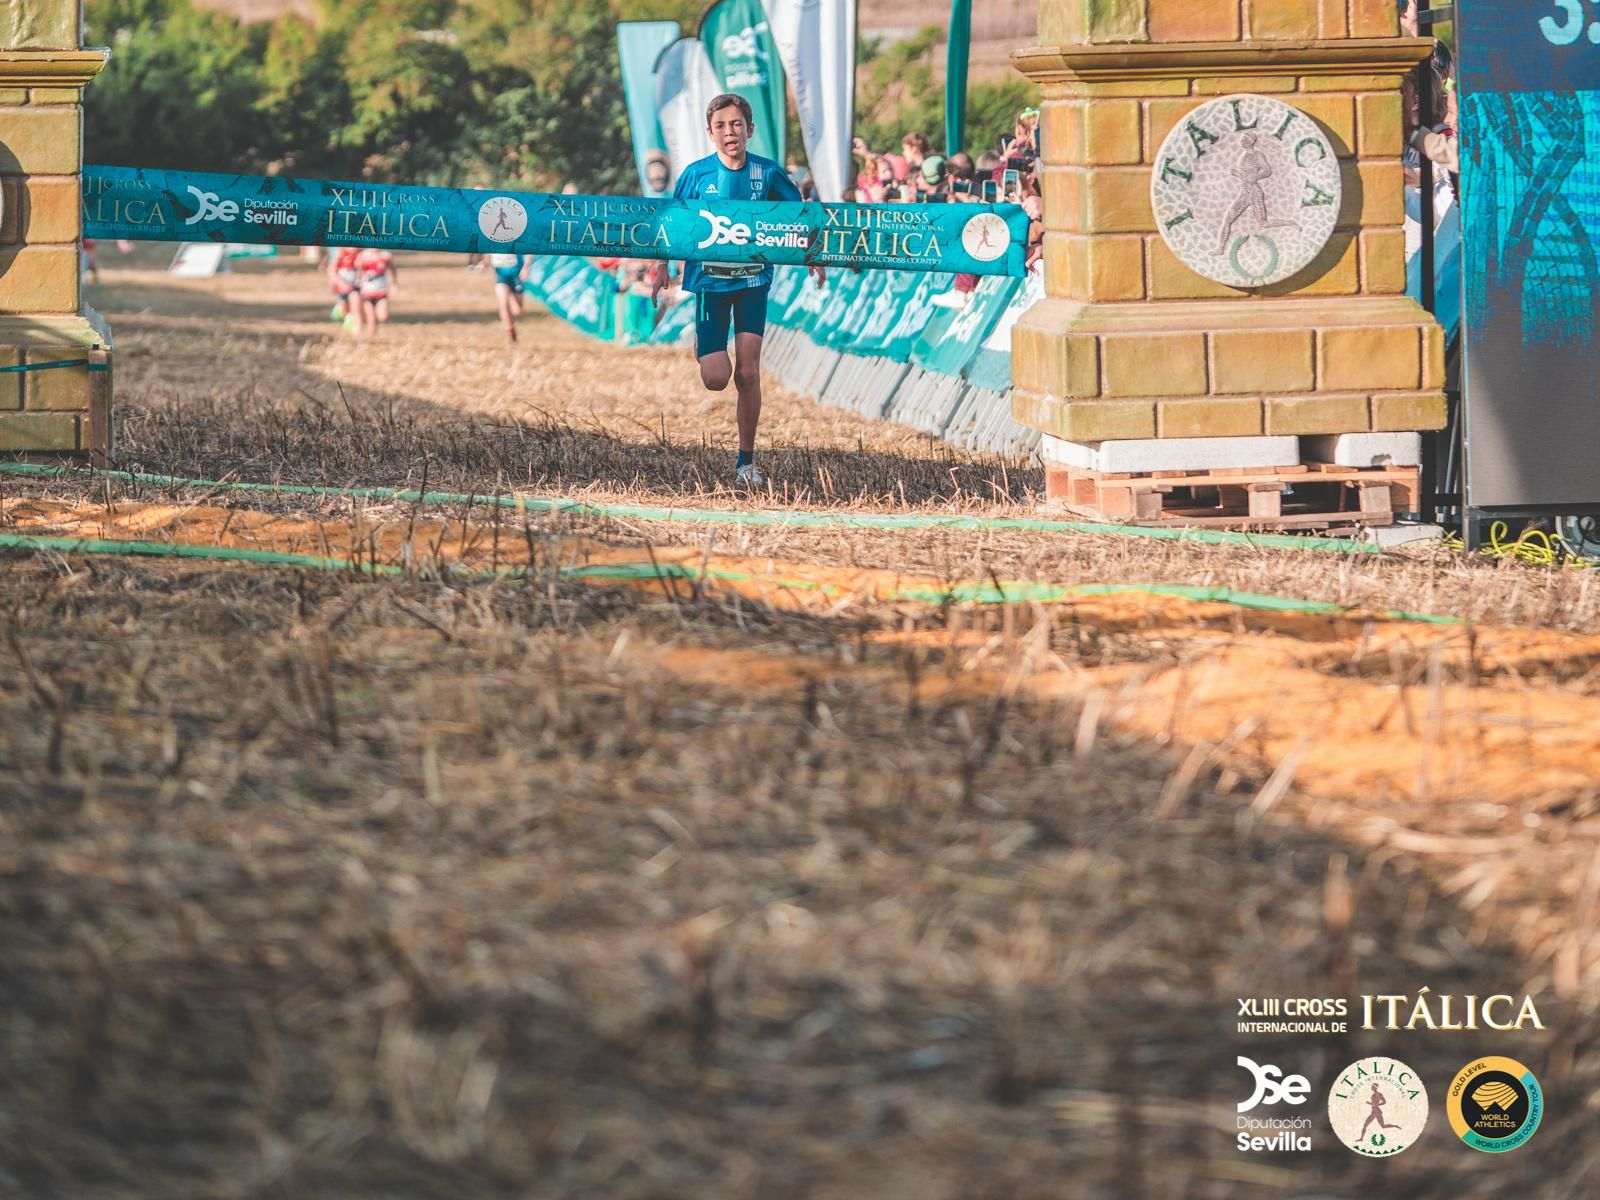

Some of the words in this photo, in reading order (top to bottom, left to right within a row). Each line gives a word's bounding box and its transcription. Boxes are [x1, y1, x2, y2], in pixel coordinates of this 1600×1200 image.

[244, 198, 298, 210] Diputación
[244, 209, 298, 225] Sevilla
[327, 206, 450, 238] ITÁLICA
[824, 208, 880, 228] XLIII
[881, 211, 929, 224] CROSS
[549, 216, 672, 247] ITÁLICA
[755, 220, 810, 232] Diputación
[755, 232, 809, 248] Sevilla
[821, 226, 943, 257] ITÁLICA
[822, 254, 881, 263] INTERNATIONAL
[907, 257, 943, 265] COUNTRY
